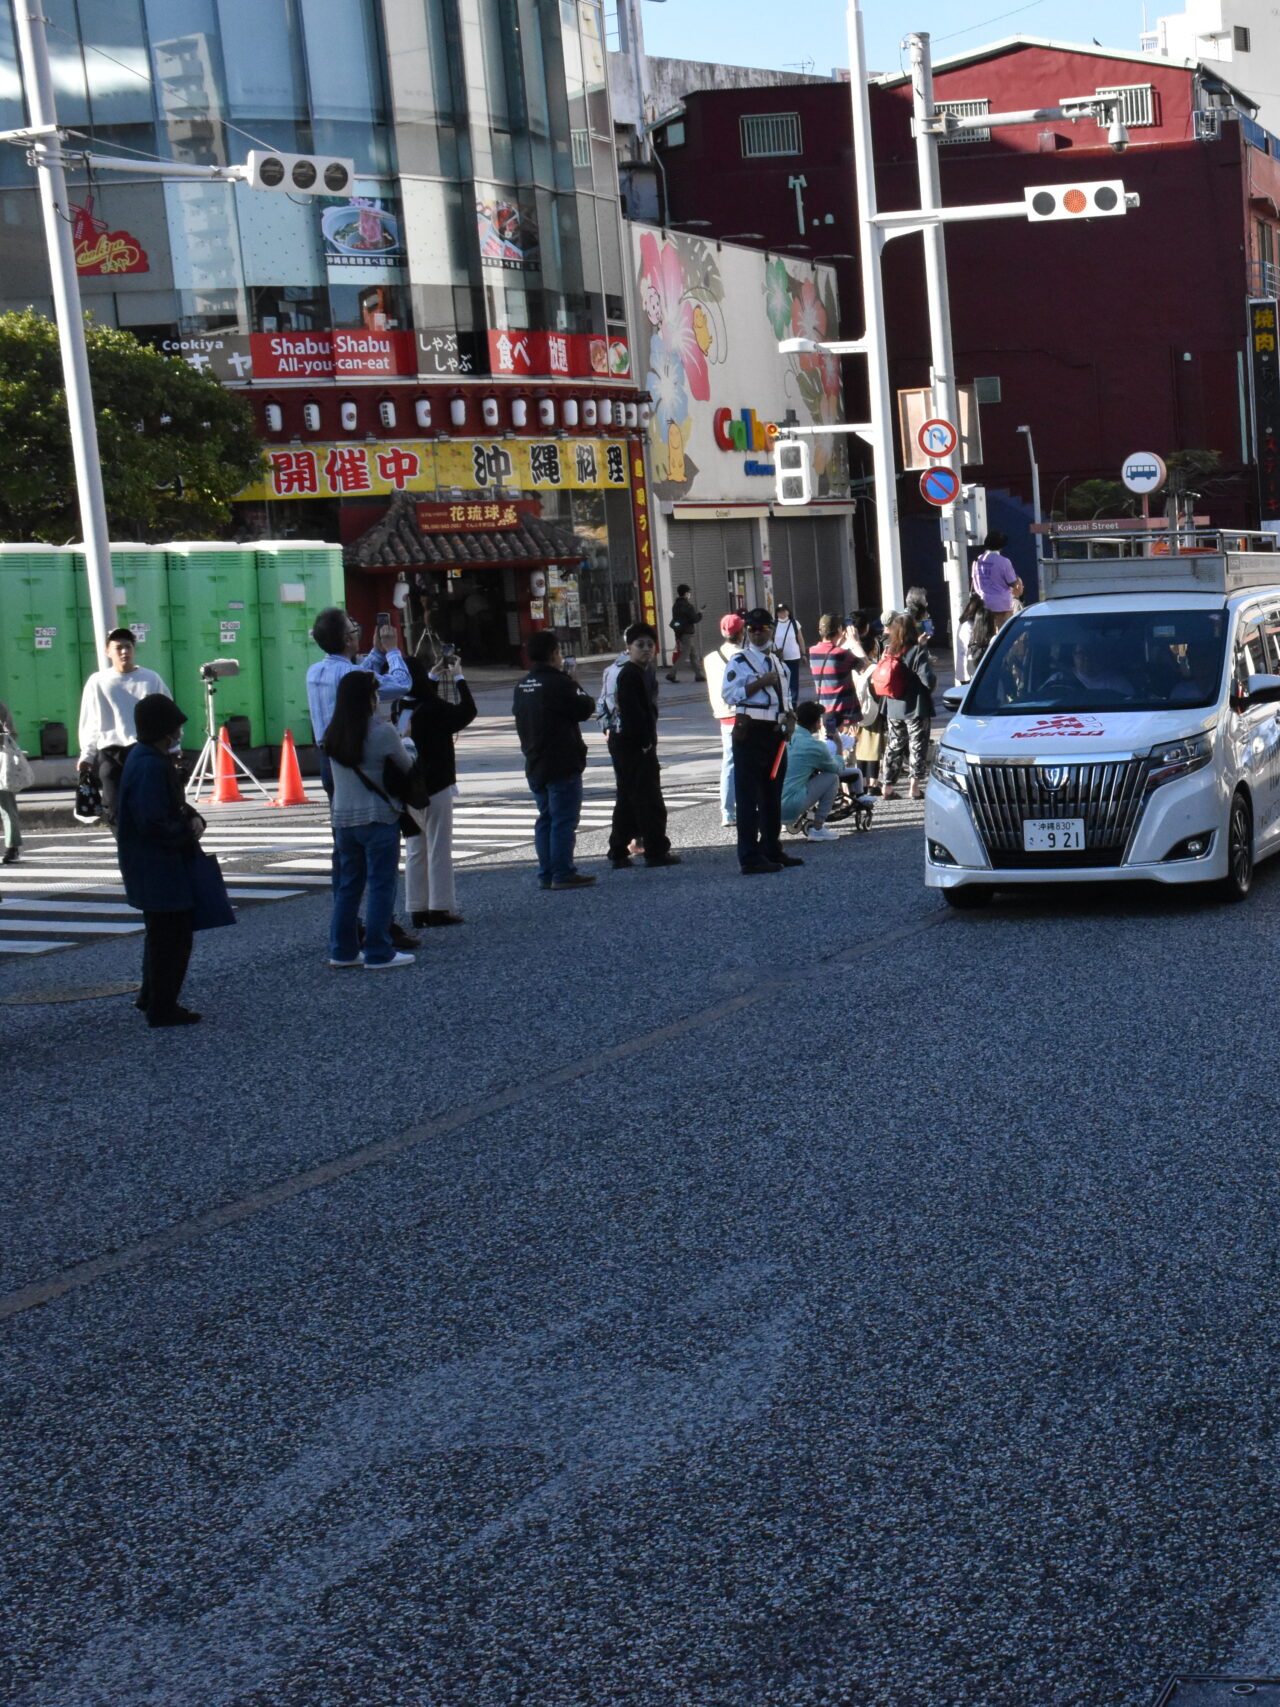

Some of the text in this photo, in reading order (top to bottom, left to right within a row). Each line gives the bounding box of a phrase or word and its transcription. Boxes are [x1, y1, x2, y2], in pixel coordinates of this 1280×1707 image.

[1254, 309, 1274, 353] 焼肉
[162, 339, 224, 352] Cookiya
[419, 333, 458, 352] しゃぶ
[434, 354, 472, 372] しゃぶ
[269, 447, 420, 495] 開催中
[472, 443, 625, 487] 沖縄料理
[449, 505, 500, 521] 花琉球
[1057, 521, 1120, 532] Kokusai Street
